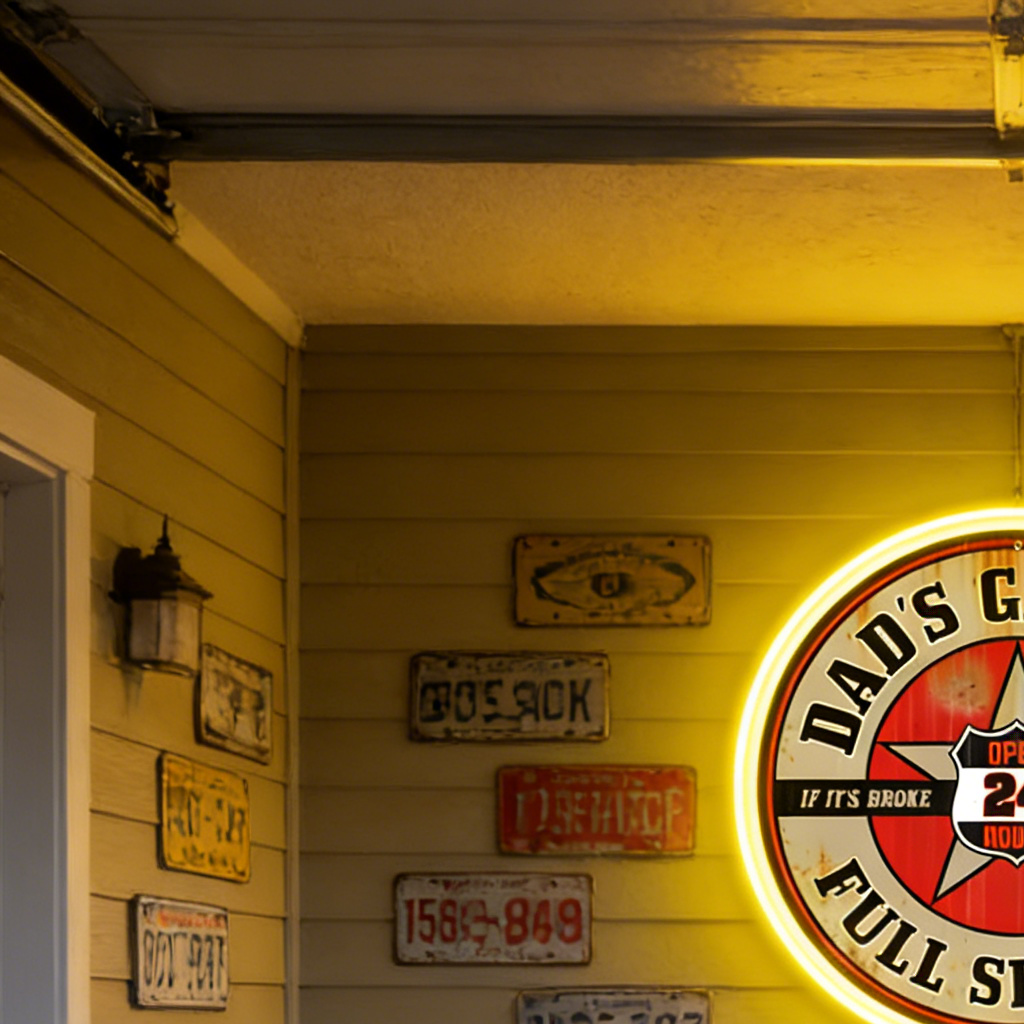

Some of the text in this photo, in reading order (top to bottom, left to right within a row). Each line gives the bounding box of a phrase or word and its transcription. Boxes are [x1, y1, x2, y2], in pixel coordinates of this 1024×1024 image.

[801, 581, 960, 756] DAD'S
[800, 789, 821, 809] IF
[867, 789, 932, 809] BROKE
[815, 857, 949, 994] FULL
